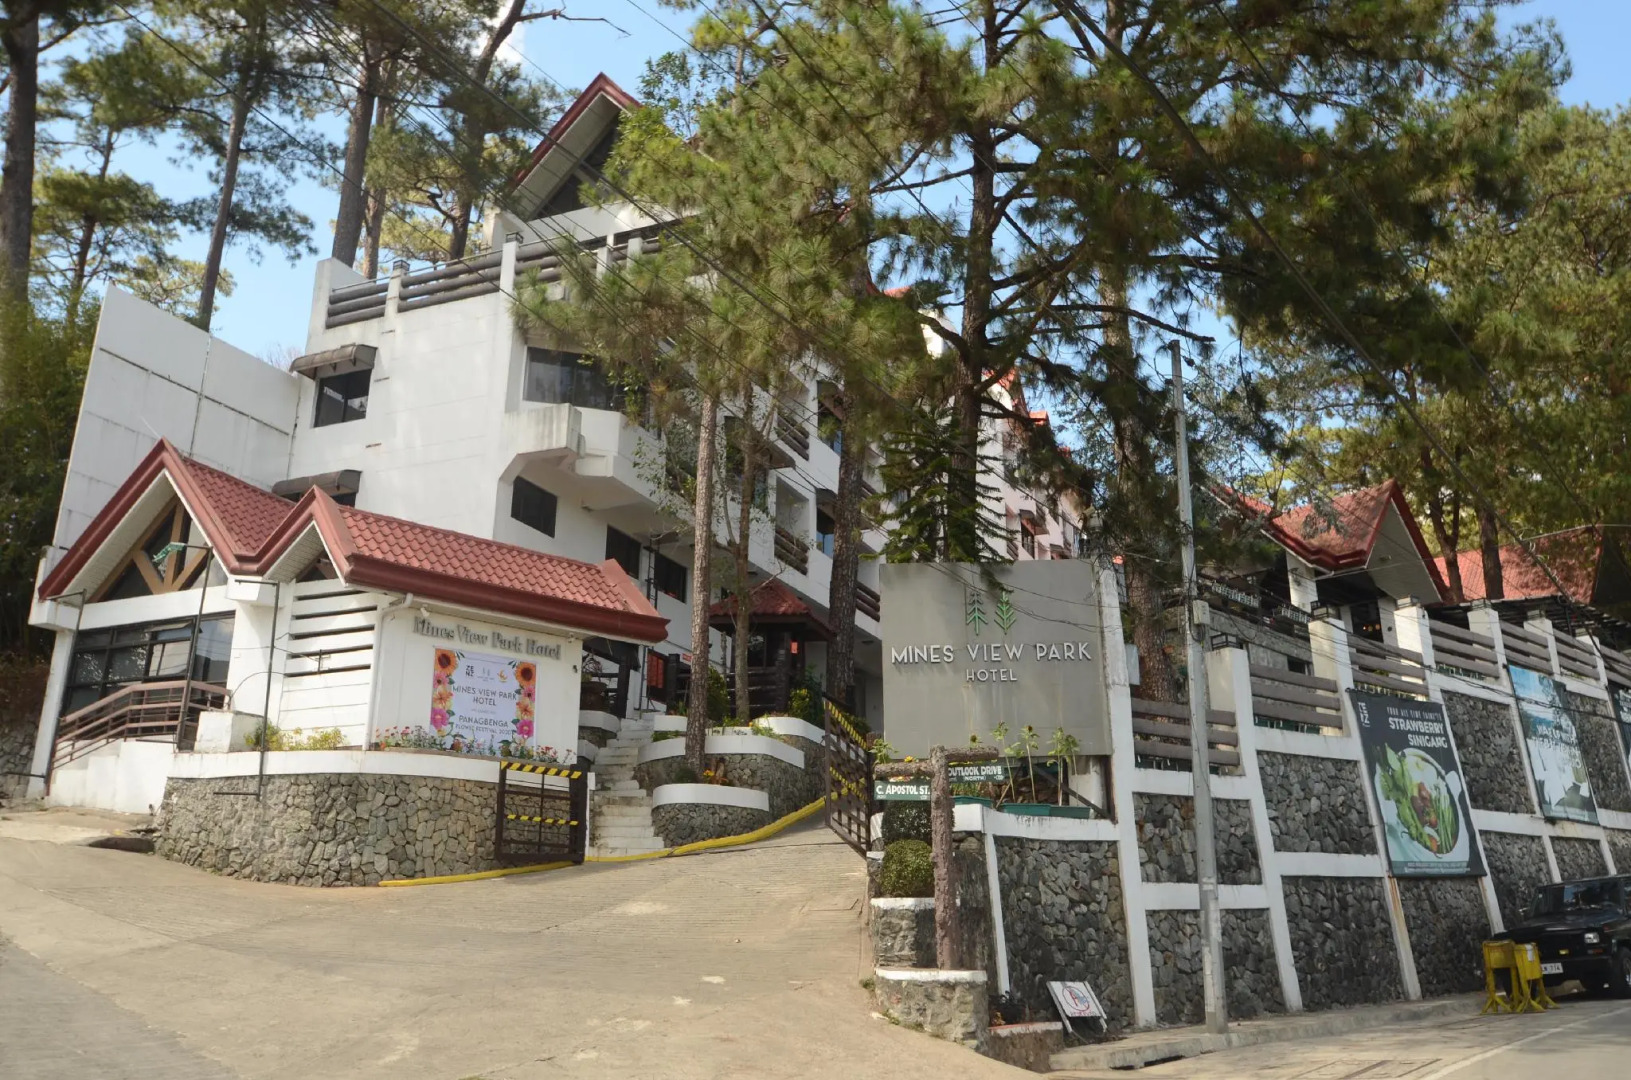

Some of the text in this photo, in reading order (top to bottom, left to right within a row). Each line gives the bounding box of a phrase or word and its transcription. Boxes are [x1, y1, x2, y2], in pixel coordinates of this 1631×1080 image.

[413, 616, 562, 660] Mines View Park Hotel
[891, 642, 1092, 664] MINES VIEW PARK
[966, 669, 1018, 682] HOTEL
[452, 686, 517, 700] MINES VIEW PARK
[473, 697, 497, 706] HOTEL
[459, 715, 508, 728] PANAGBENGA
[1388, 717, 1444, 734] STRAWBERRY
[1408, 733, 1448, 748] SINIGANG
[981, 765, 1003, 776] DRIVE
[876, 785, 931, 795] C. APOSTOL ST.
